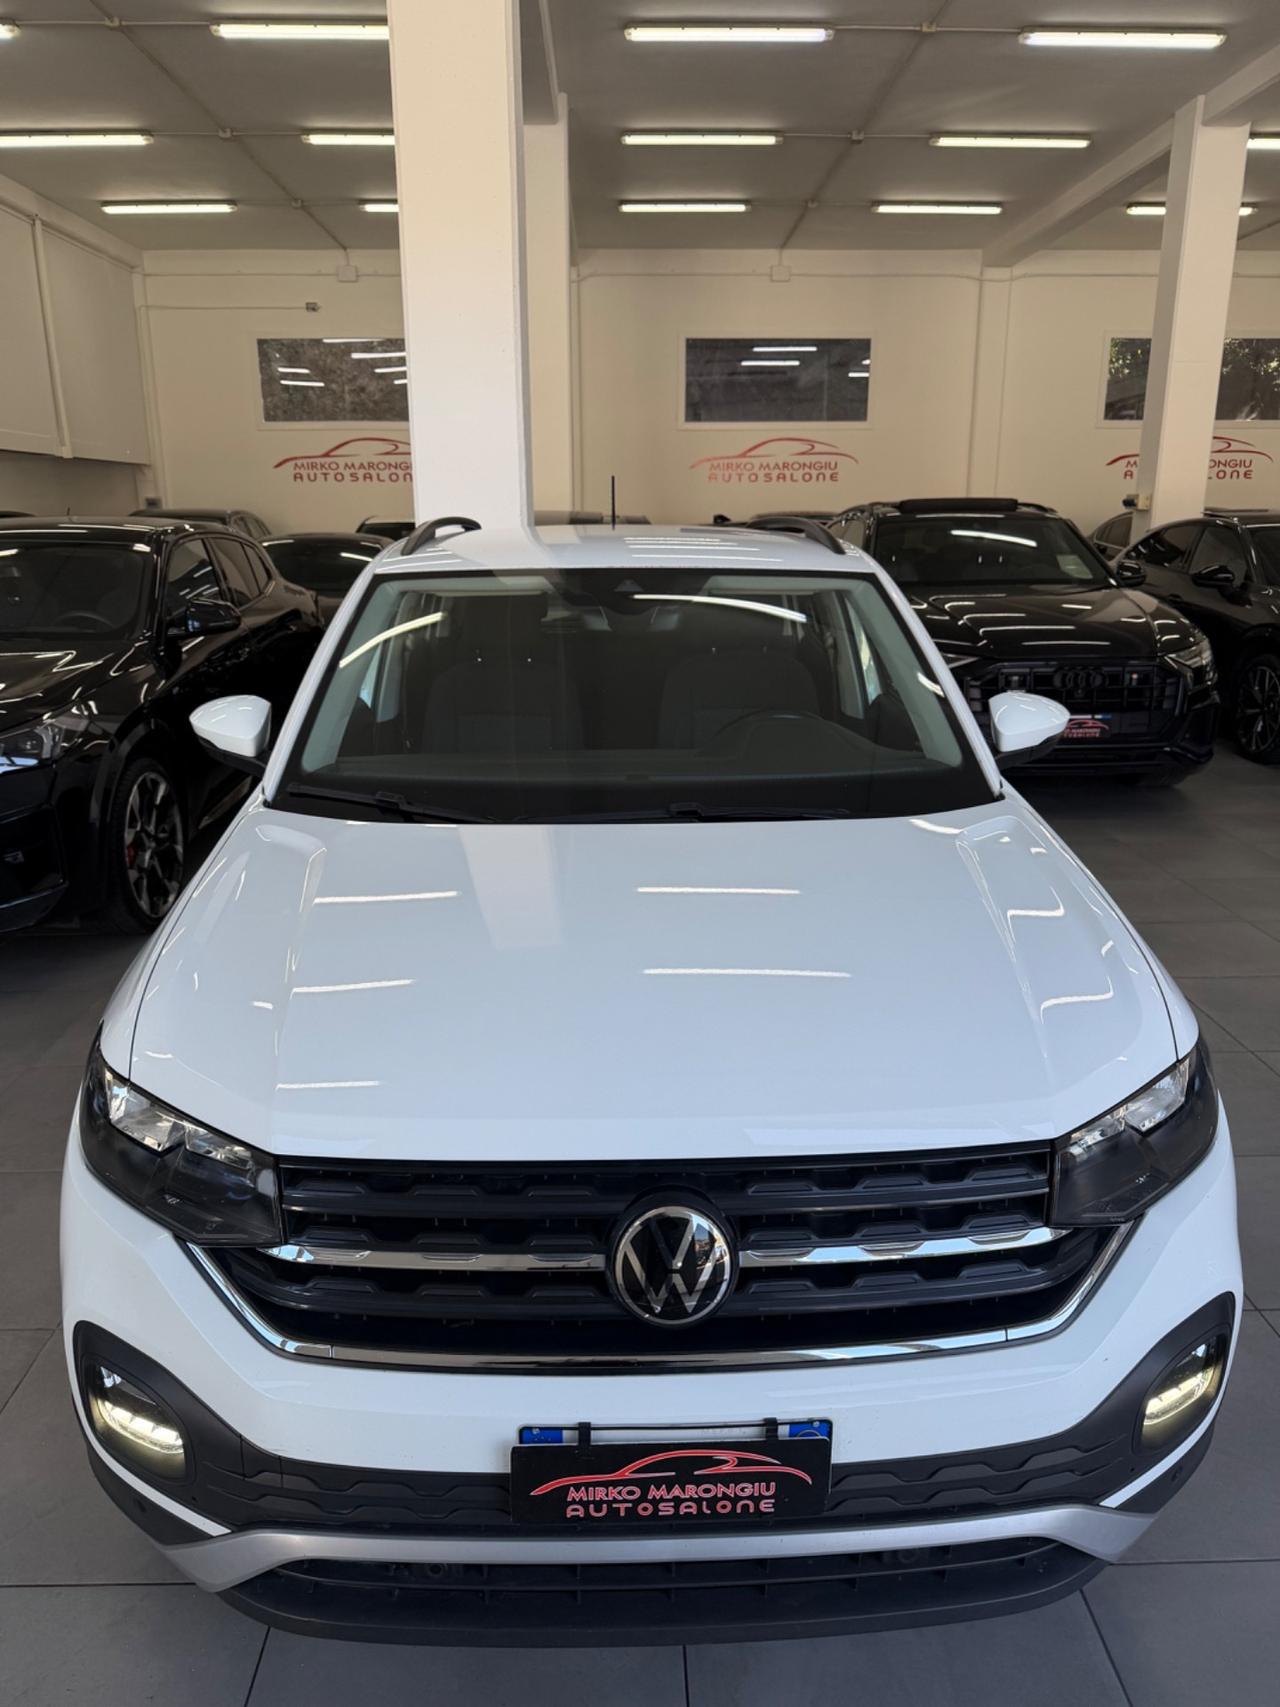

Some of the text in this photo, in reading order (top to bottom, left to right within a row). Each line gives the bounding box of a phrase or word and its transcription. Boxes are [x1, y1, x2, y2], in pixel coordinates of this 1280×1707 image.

[293, 461, 412, 471] MIRKO MARONG
[709, 461, 838, 471] MIRKO MARONGIU
[293, 472, 413, 482] AUTOSALON
[708, 472, 839, 482] AUTOSALONE
[566, 1481, 776, 1501] MIRKO MARONGIU
[566, 1499, 776, 1518] AUTOSALONE
